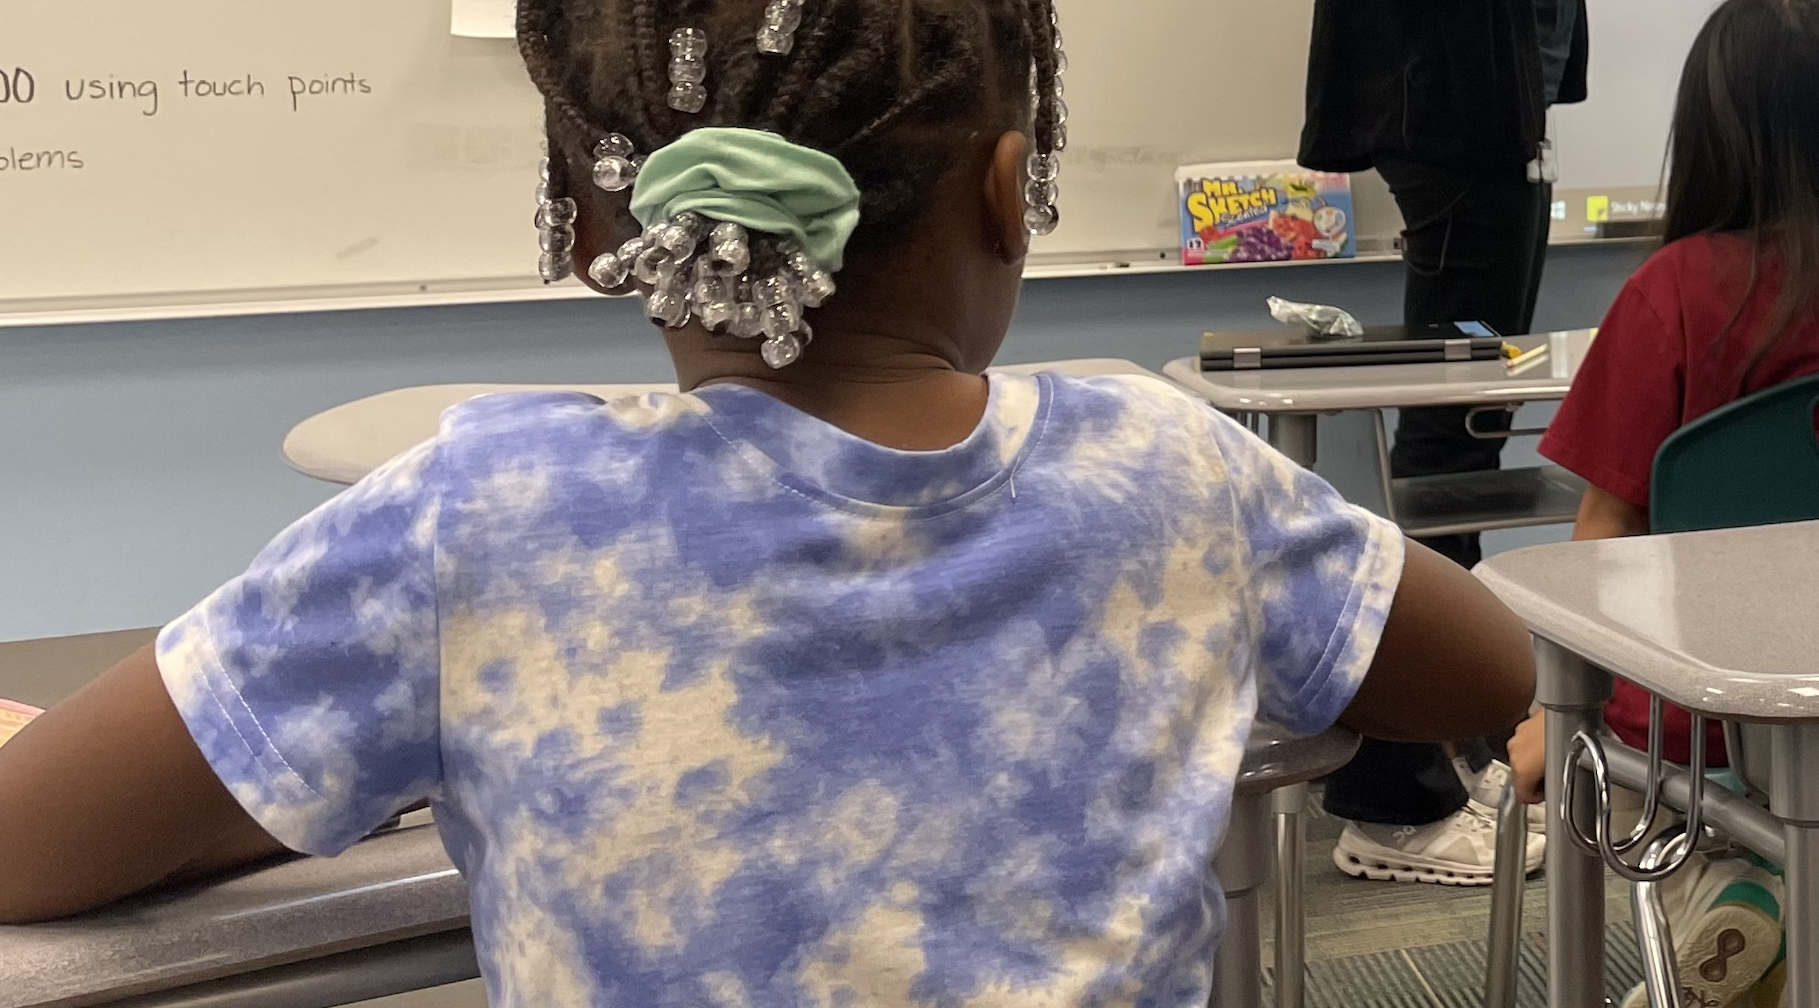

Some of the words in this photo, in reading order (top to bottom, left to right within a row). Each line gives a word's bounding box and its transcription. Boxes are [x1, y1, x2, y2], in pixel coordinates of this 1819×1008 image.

[65, 78, 158, 116] using
[178, 70, 265, 98] touch
[289, 72, 372, 112] points
[1187, 188, 1277, 233] SKETCH
